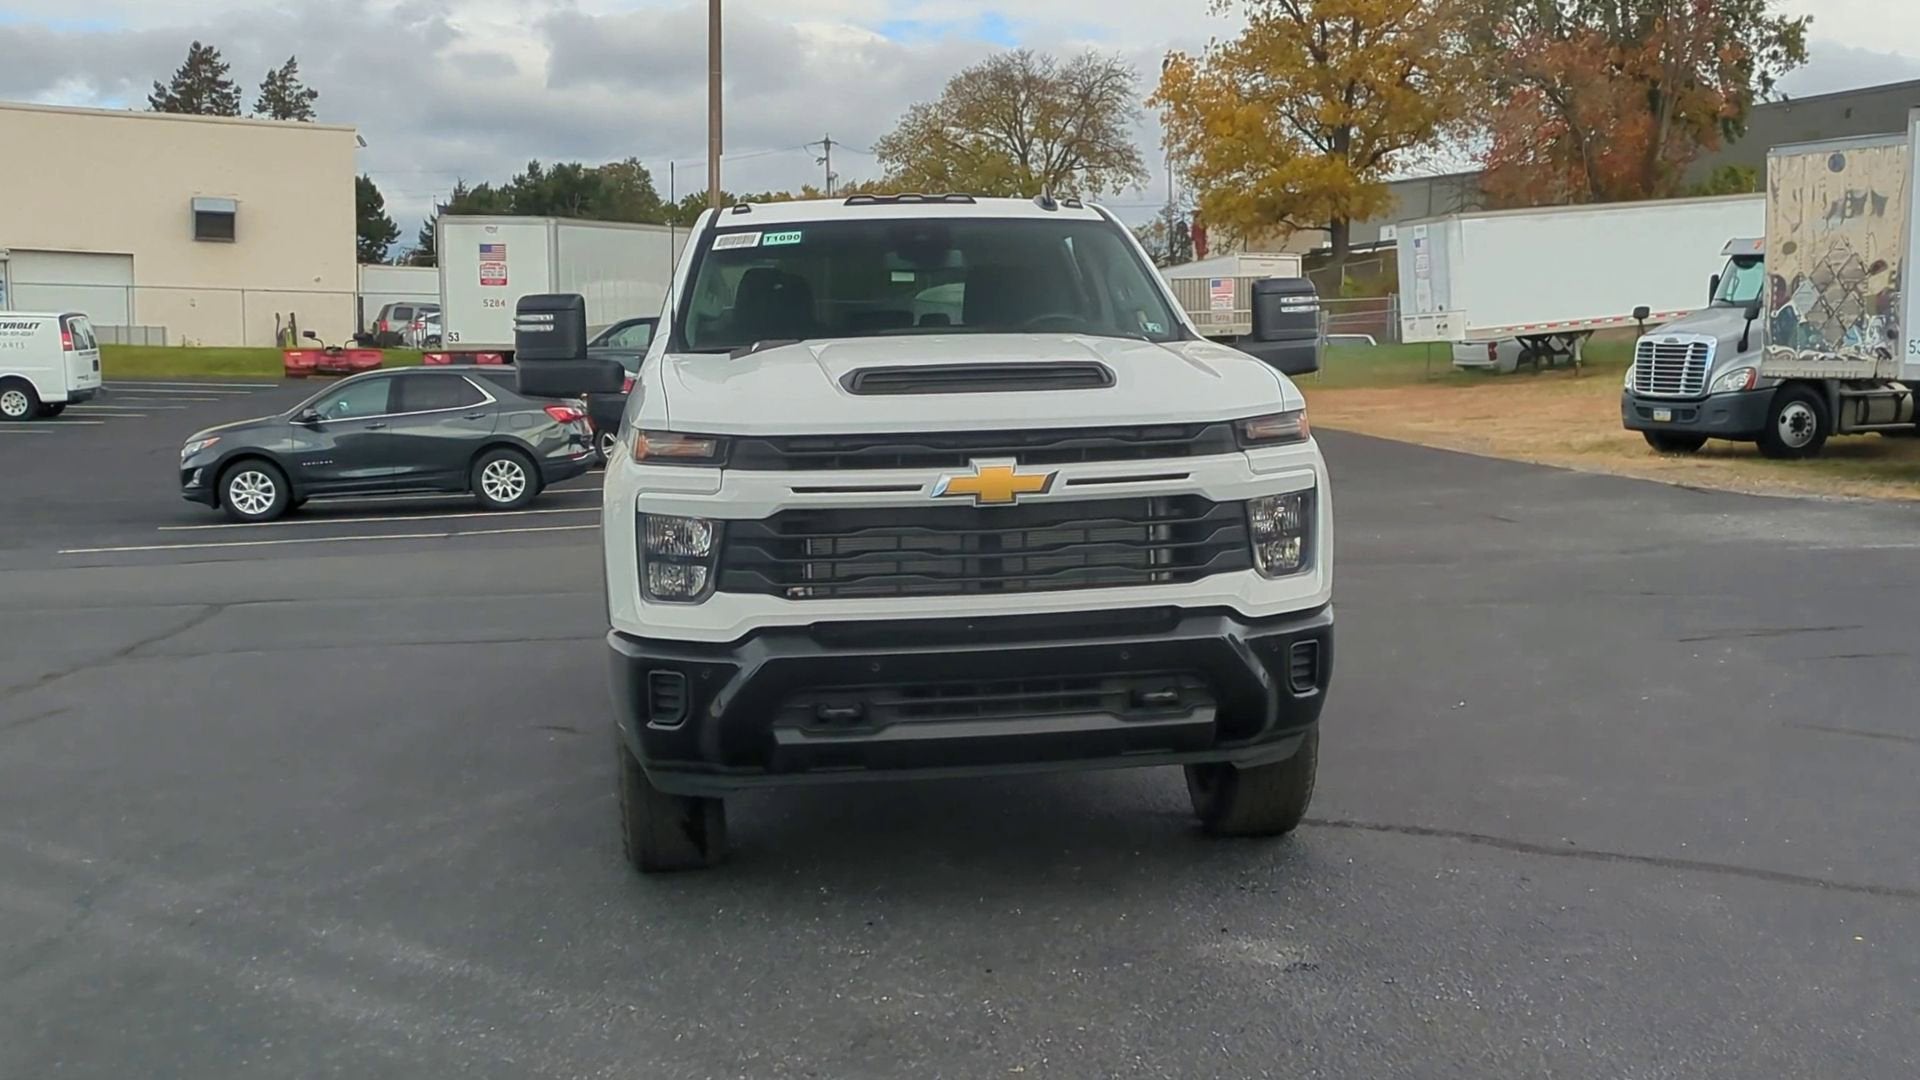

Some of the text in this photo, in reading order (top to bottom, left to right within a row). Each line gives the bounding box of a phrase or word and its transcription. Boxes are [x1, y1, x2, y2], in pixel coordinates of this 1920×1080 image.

[766, 234, 800, 243] T1090
[448, 332, 460, 342] 53
[0, 342, 25, 350] ARTS
